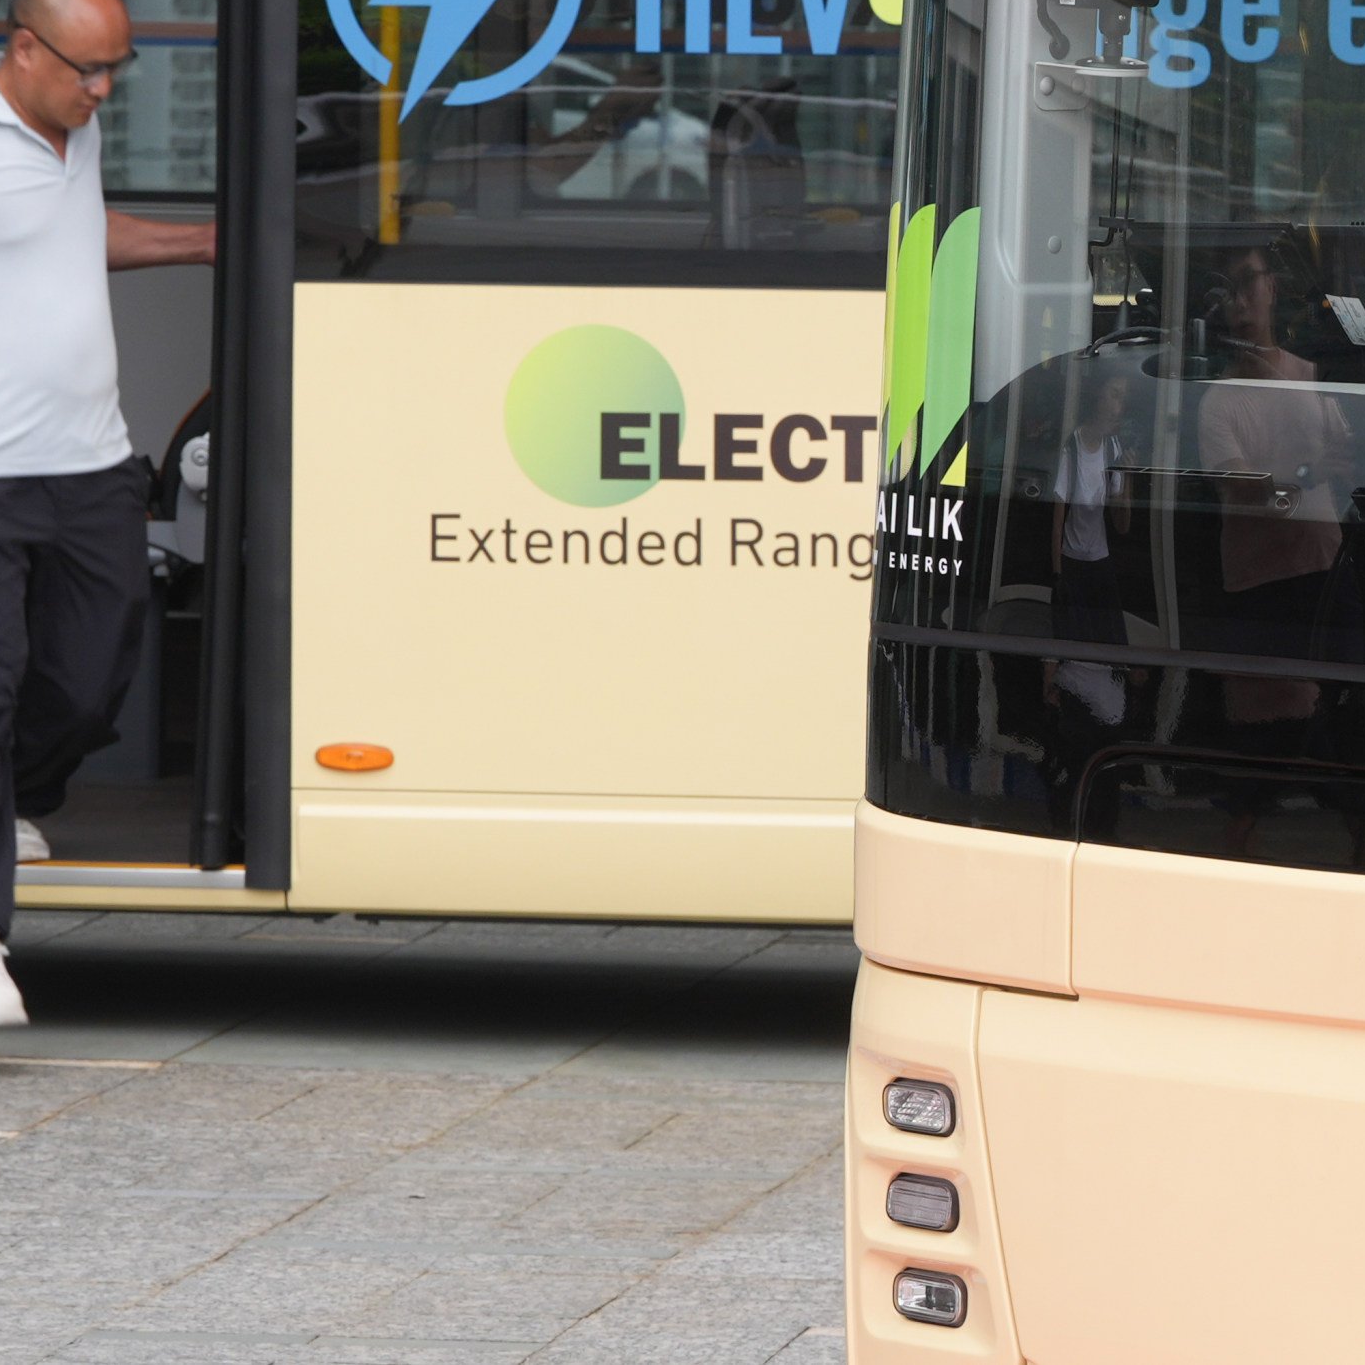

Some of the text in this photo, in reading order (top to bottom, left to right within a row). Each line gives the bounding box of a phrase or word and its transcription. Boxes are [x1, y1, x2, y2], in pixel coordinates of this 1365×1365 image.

[599, 412, 878, 482] ELECT
[430, 513, 874, 581] Extended Rang
[888, 551, 963, 576] ENERGY
